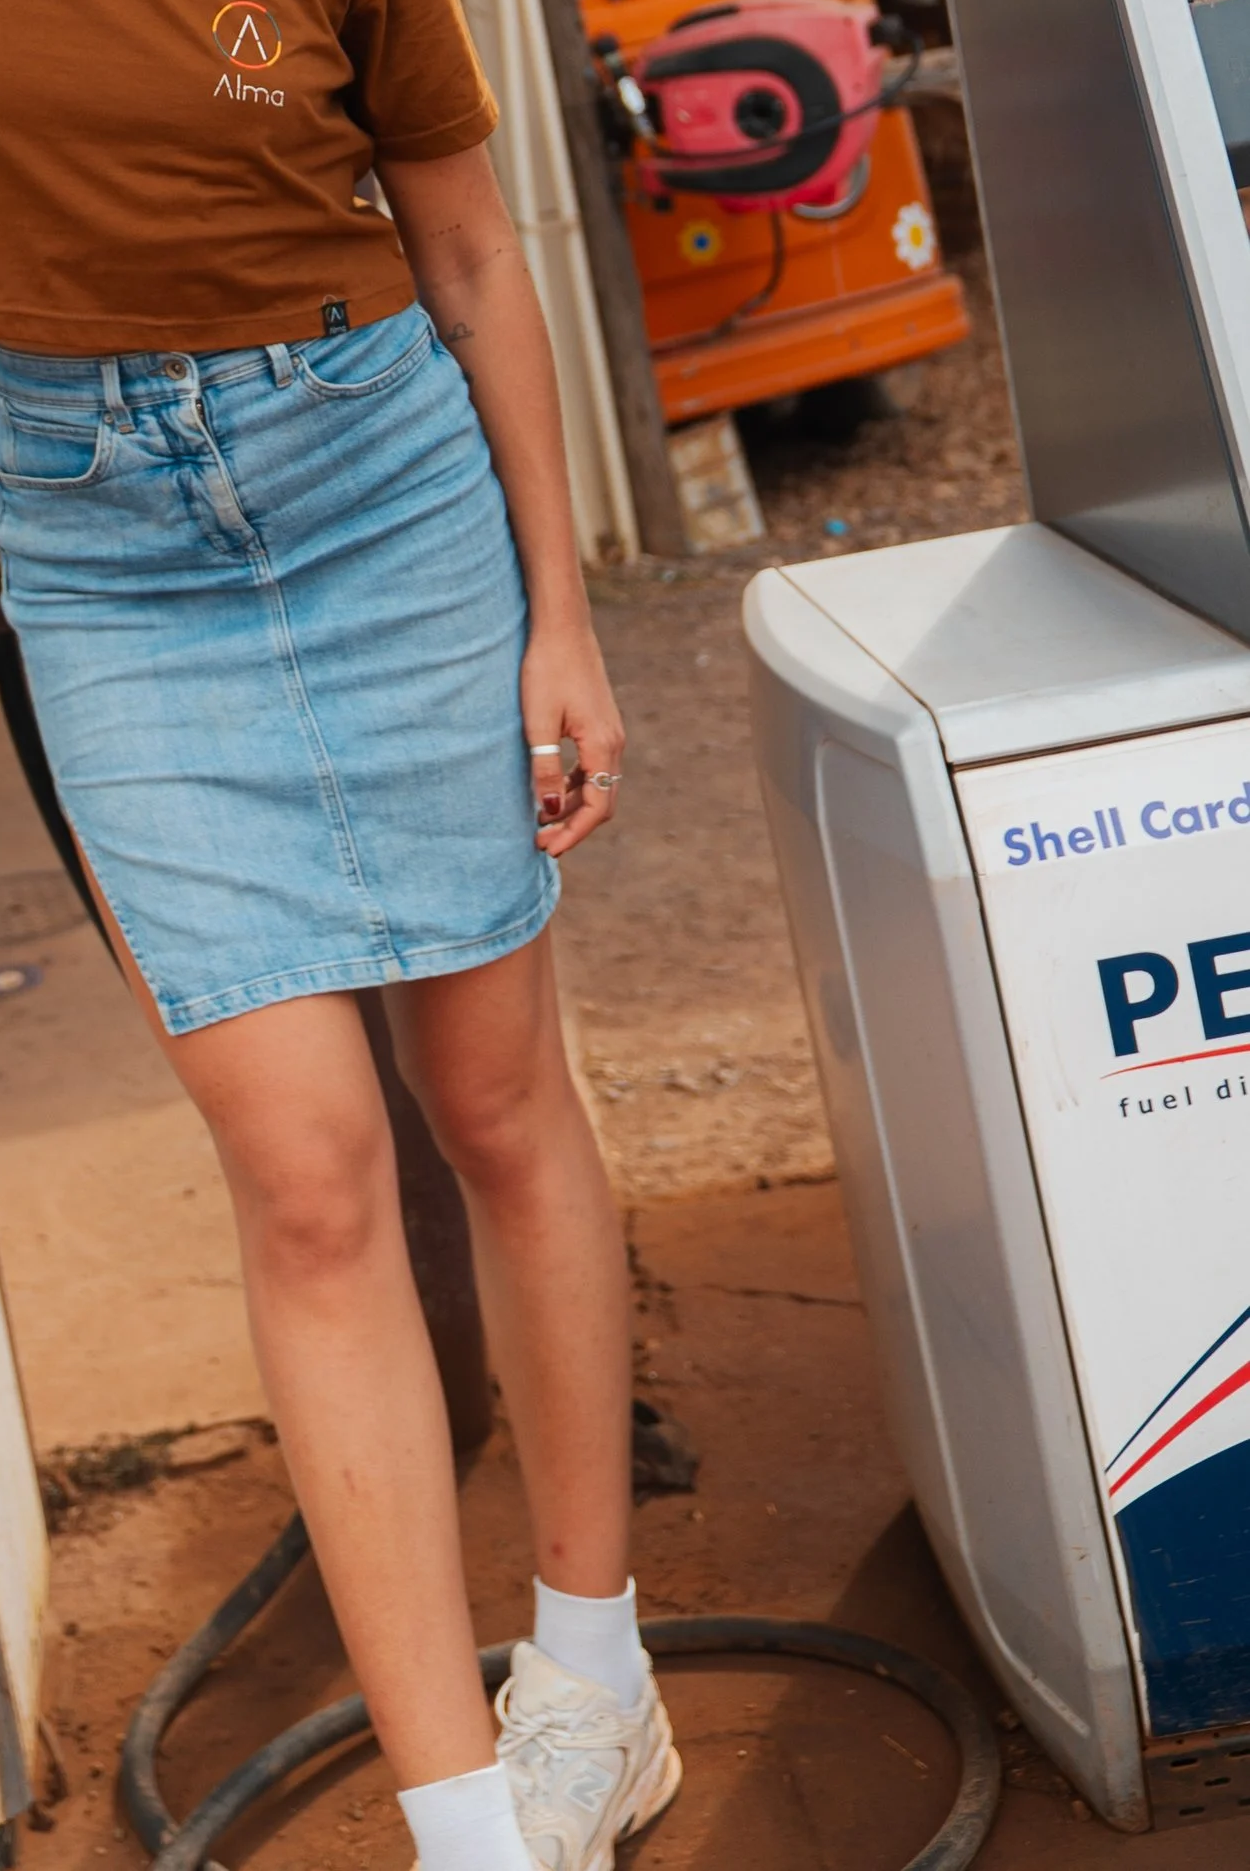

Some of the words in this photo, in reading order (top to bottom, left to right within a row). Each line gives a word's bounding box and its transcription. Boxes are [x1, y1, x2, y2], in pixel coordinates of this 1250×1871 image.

[213, 73, 285, 107] Alma
[1004, 806, 1126, 866] Shell
[1141, 781, 1250, 840] Card
[1097, 931, 1250, 1057] PE
[1119, 1086, 1192, 1117] fuel
